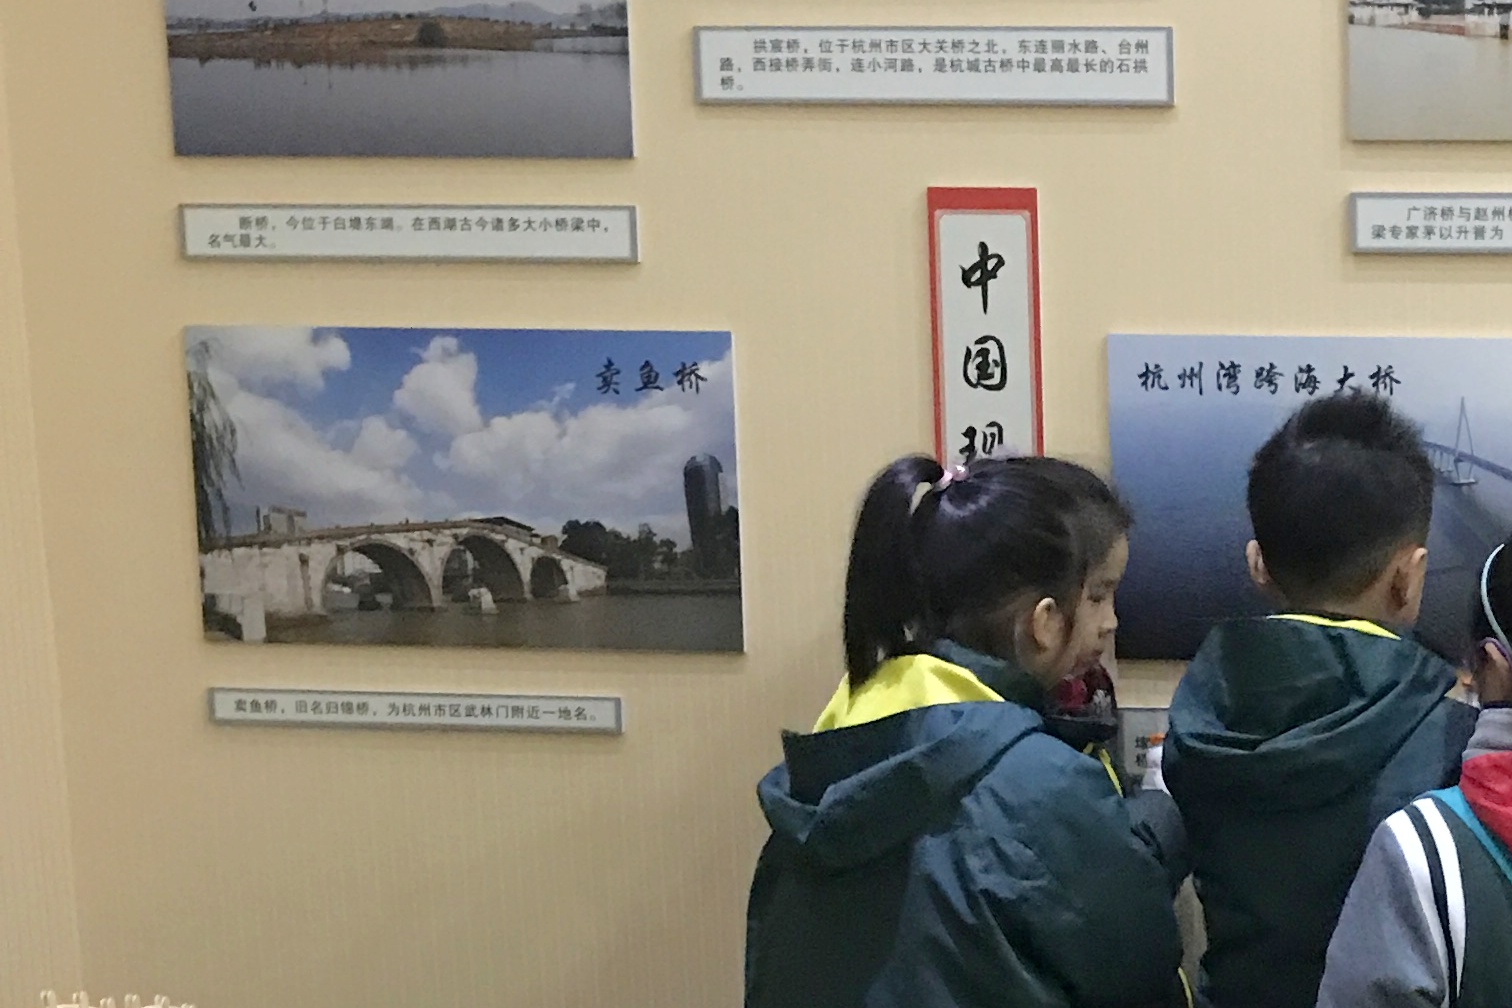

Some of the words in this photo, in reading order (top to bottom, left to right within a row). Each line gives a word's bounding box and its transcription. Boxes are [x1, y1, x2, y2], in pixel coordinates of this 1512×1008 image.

[596, 356, 708, 396] 卖鱼桥
[1137, 360, 1402, 396] 杭州湾跨海大桥
